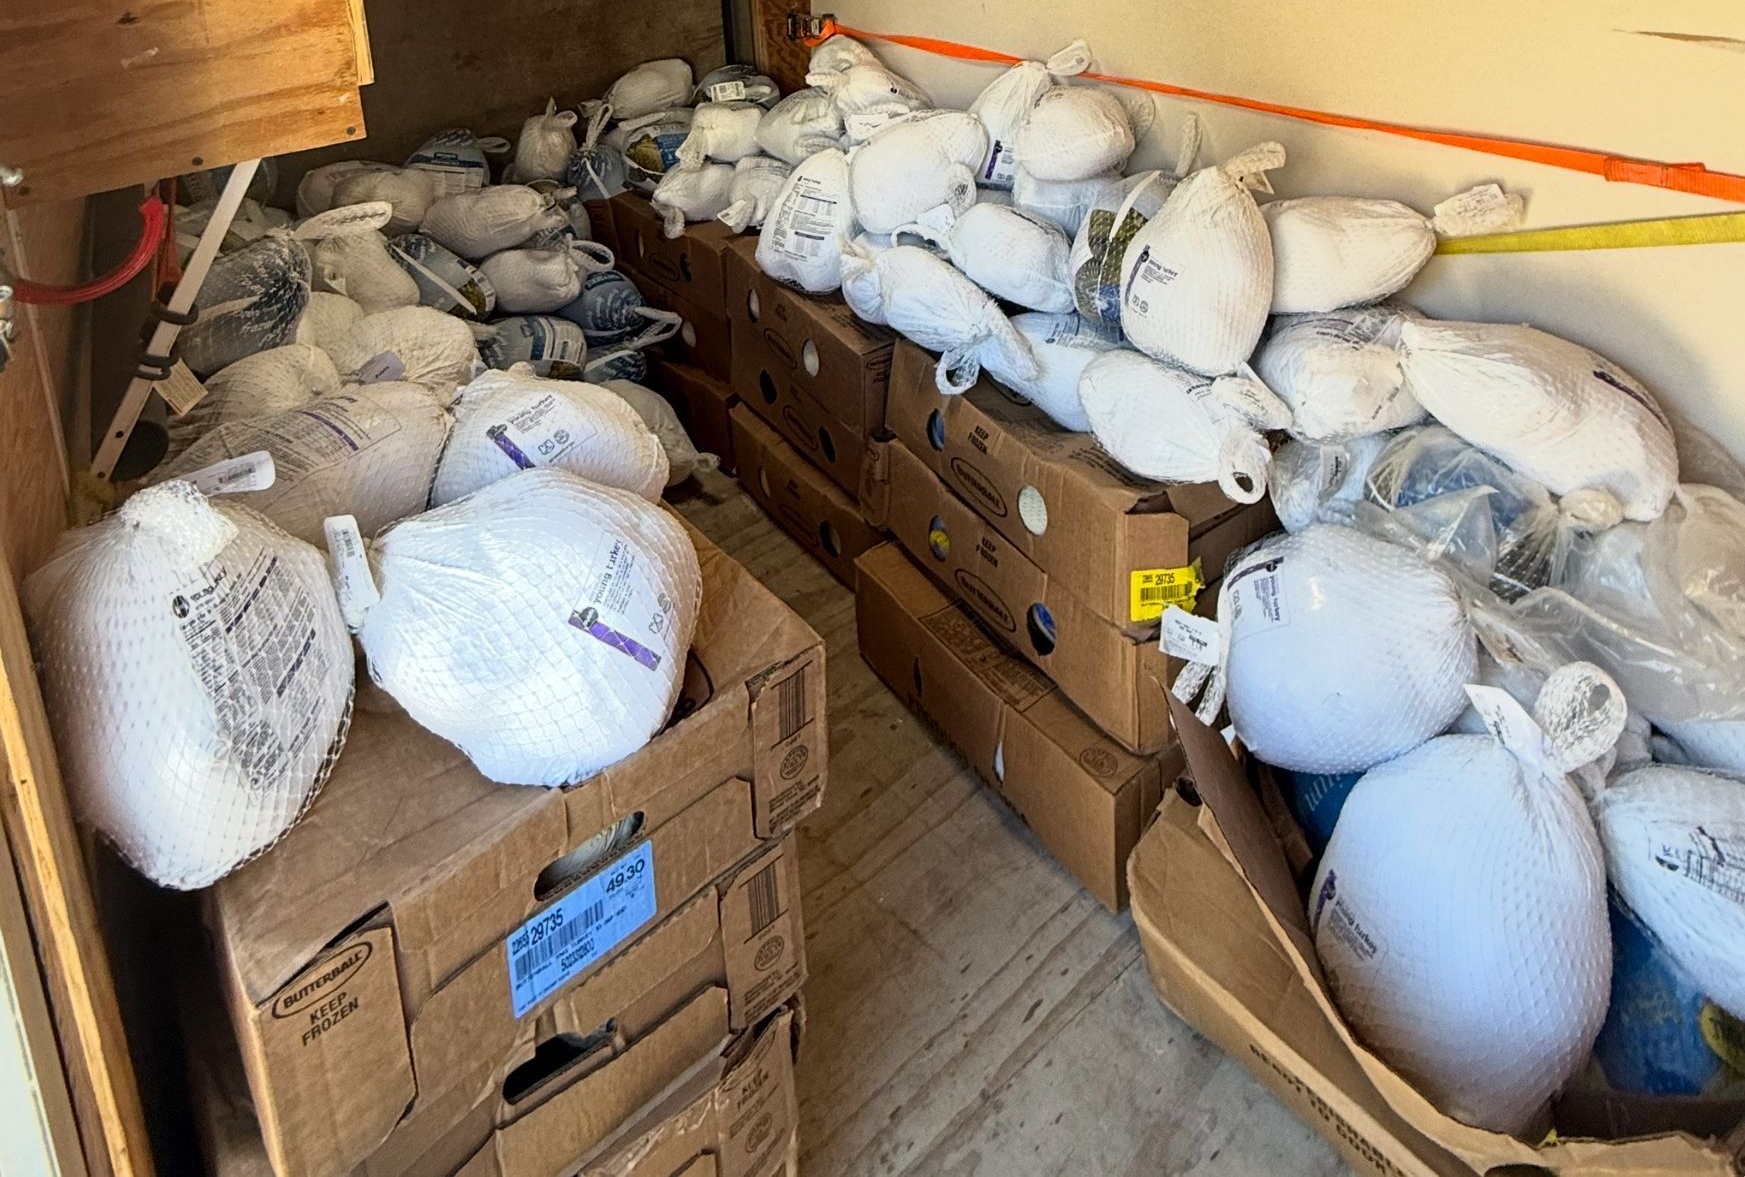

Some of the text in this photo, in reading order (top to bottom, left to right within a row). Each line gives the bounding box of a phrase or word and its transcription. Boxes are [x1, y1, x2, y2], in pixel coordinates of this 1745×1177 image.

[593, 573, 614, 605] young
[1154, 572, 1176, 586] 29735
[605, 858, 646, 894] 49.30
[530, 908, 565, 946] 29735
[282, 949, 364, 1010] BUTTERBALL
[301, 996, 360, 1047] FROZEN
[309, 991, 348, 1026] KEEP
